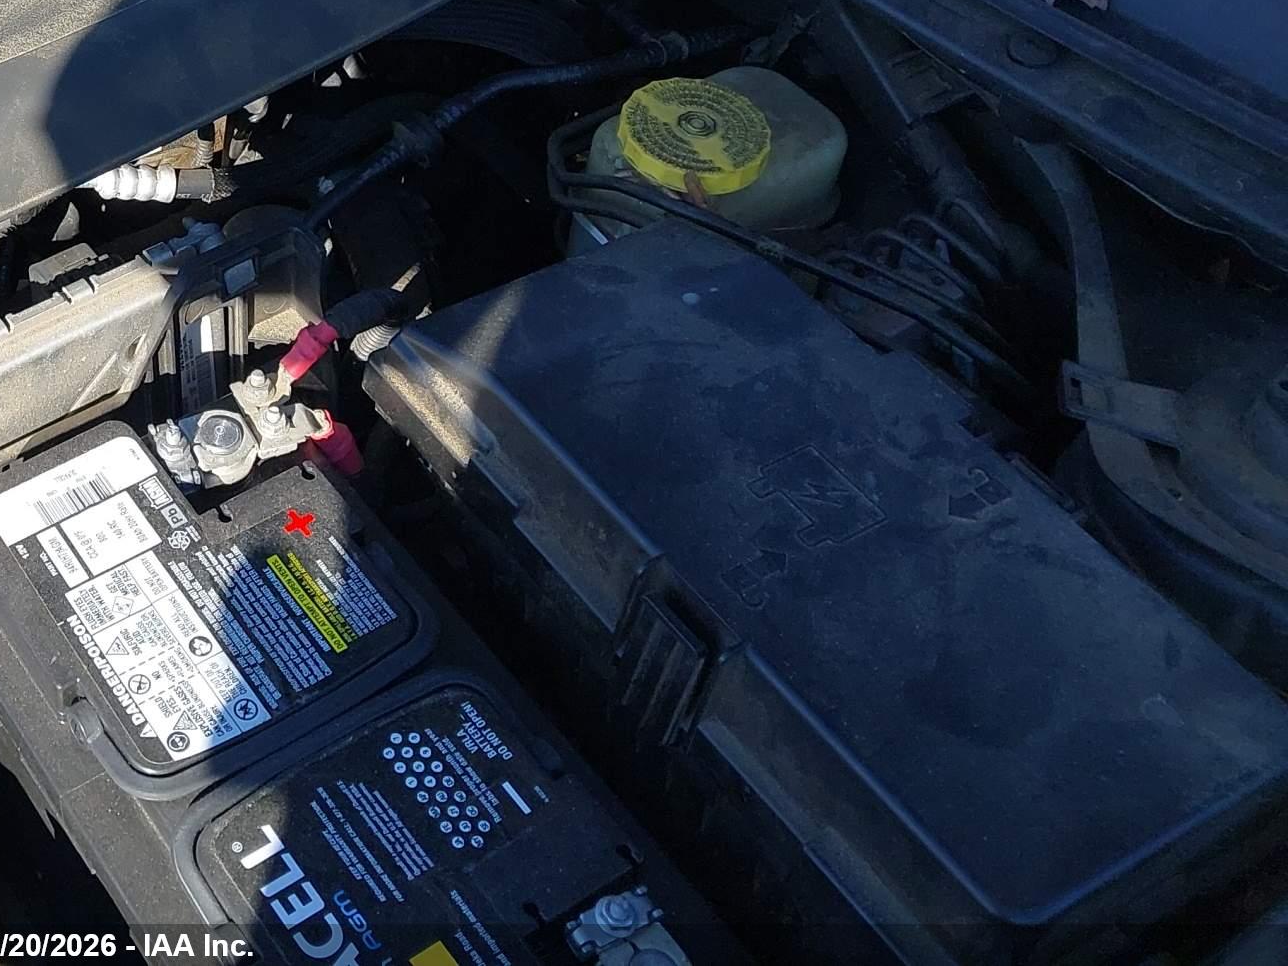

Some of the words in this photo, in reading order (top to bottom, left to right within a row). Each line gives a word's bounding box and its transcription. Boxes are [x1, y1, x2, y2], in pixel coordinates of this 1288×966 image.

[141, 478, 170, 506] AGM
[164, 506, 183, 524] Pb
[14, 542, 31, 560] 12V
[115, 565, 132, 582] FAST.
[144, 576, 155, 587] NOT
[105, 581, 118, 594] GET
[108, 570, 130, 596] MEDICAL
[126, 581, 142, 597] HELP
[150, 585, 161, 595] DO
[153, 576, 168, 591] OPEN
[261, 566, 304, 615] NONSERVICEABLE
[284, 577, 302, 594] OPEN
[86, 584, 106, 606] WATER.
[297, 593, 308, 602] TO
[73, 596, 88, 612] EYES
[78, 587, 108, 626] IMMEDIATELY
[82, 611, 99, 630] FLUSH
[100, 605, 115, 621] WITH
[139, 612, 149, 621] OR
[170, 613, 181, 623] ALL
[303, 601, 327, 626] ATTEMPT
[131, 629, 146, 644] ACID
[135, 620, 150, 637] CAUSE
[144, 620, 167, 647] BLINDNESS
[176, 621, 191, 637] READ
[300, 617, 332, 651] IMPORTANT
[322, 626, 337, 639] NOT
[119, 627, 143, 656] SULFURIC
[146, 636, 157, 647] CAN
[332, 638, 345, 649] DO
[65, 613, 146, 726] DANGER/POISON
[204, 668, 215, 676] OF
[209, 661, 219, 669] OF
[150, 670, 162, 680] NO
[209, 675, 223, 689] OUT
[214, 668, 233, 688] REACH
[172, 685, 191, 705] GASES
[181, 679, 206, 709] BLINDNESS
[217, 687, 233, 702] KEEP
[226, 686, 240, 698] THE
[153, 695, 173, 718] SHIELD
[185, 704, 213, 737] EXPLOSIVE
[201, 708, 217, 726] CAUSE
[211, 724, 225, 737] CAN
[222, 722, 233, 732] OR
[423, 727, 439, 743] year
[455, 728, 480, 753] VRLA
[461, 719, 497, 758] BATTERY
[482, 727, 502, 746] NOT
[434, 741, 448, 754] and
[496, 744, 513, 760] DO
[444, 753, 465, 775] month
[453, 751, 468, 766] date
[464, 765, 482, 784] show
[459, 773, 482, 796] proper
[478, 782, 488, 791] to
[476, 794, 503, 822] Remove
[447, 888, 478, 923] materials
[330, 889, 382, 951] AGM
[472, 921, 501, 954] imported
